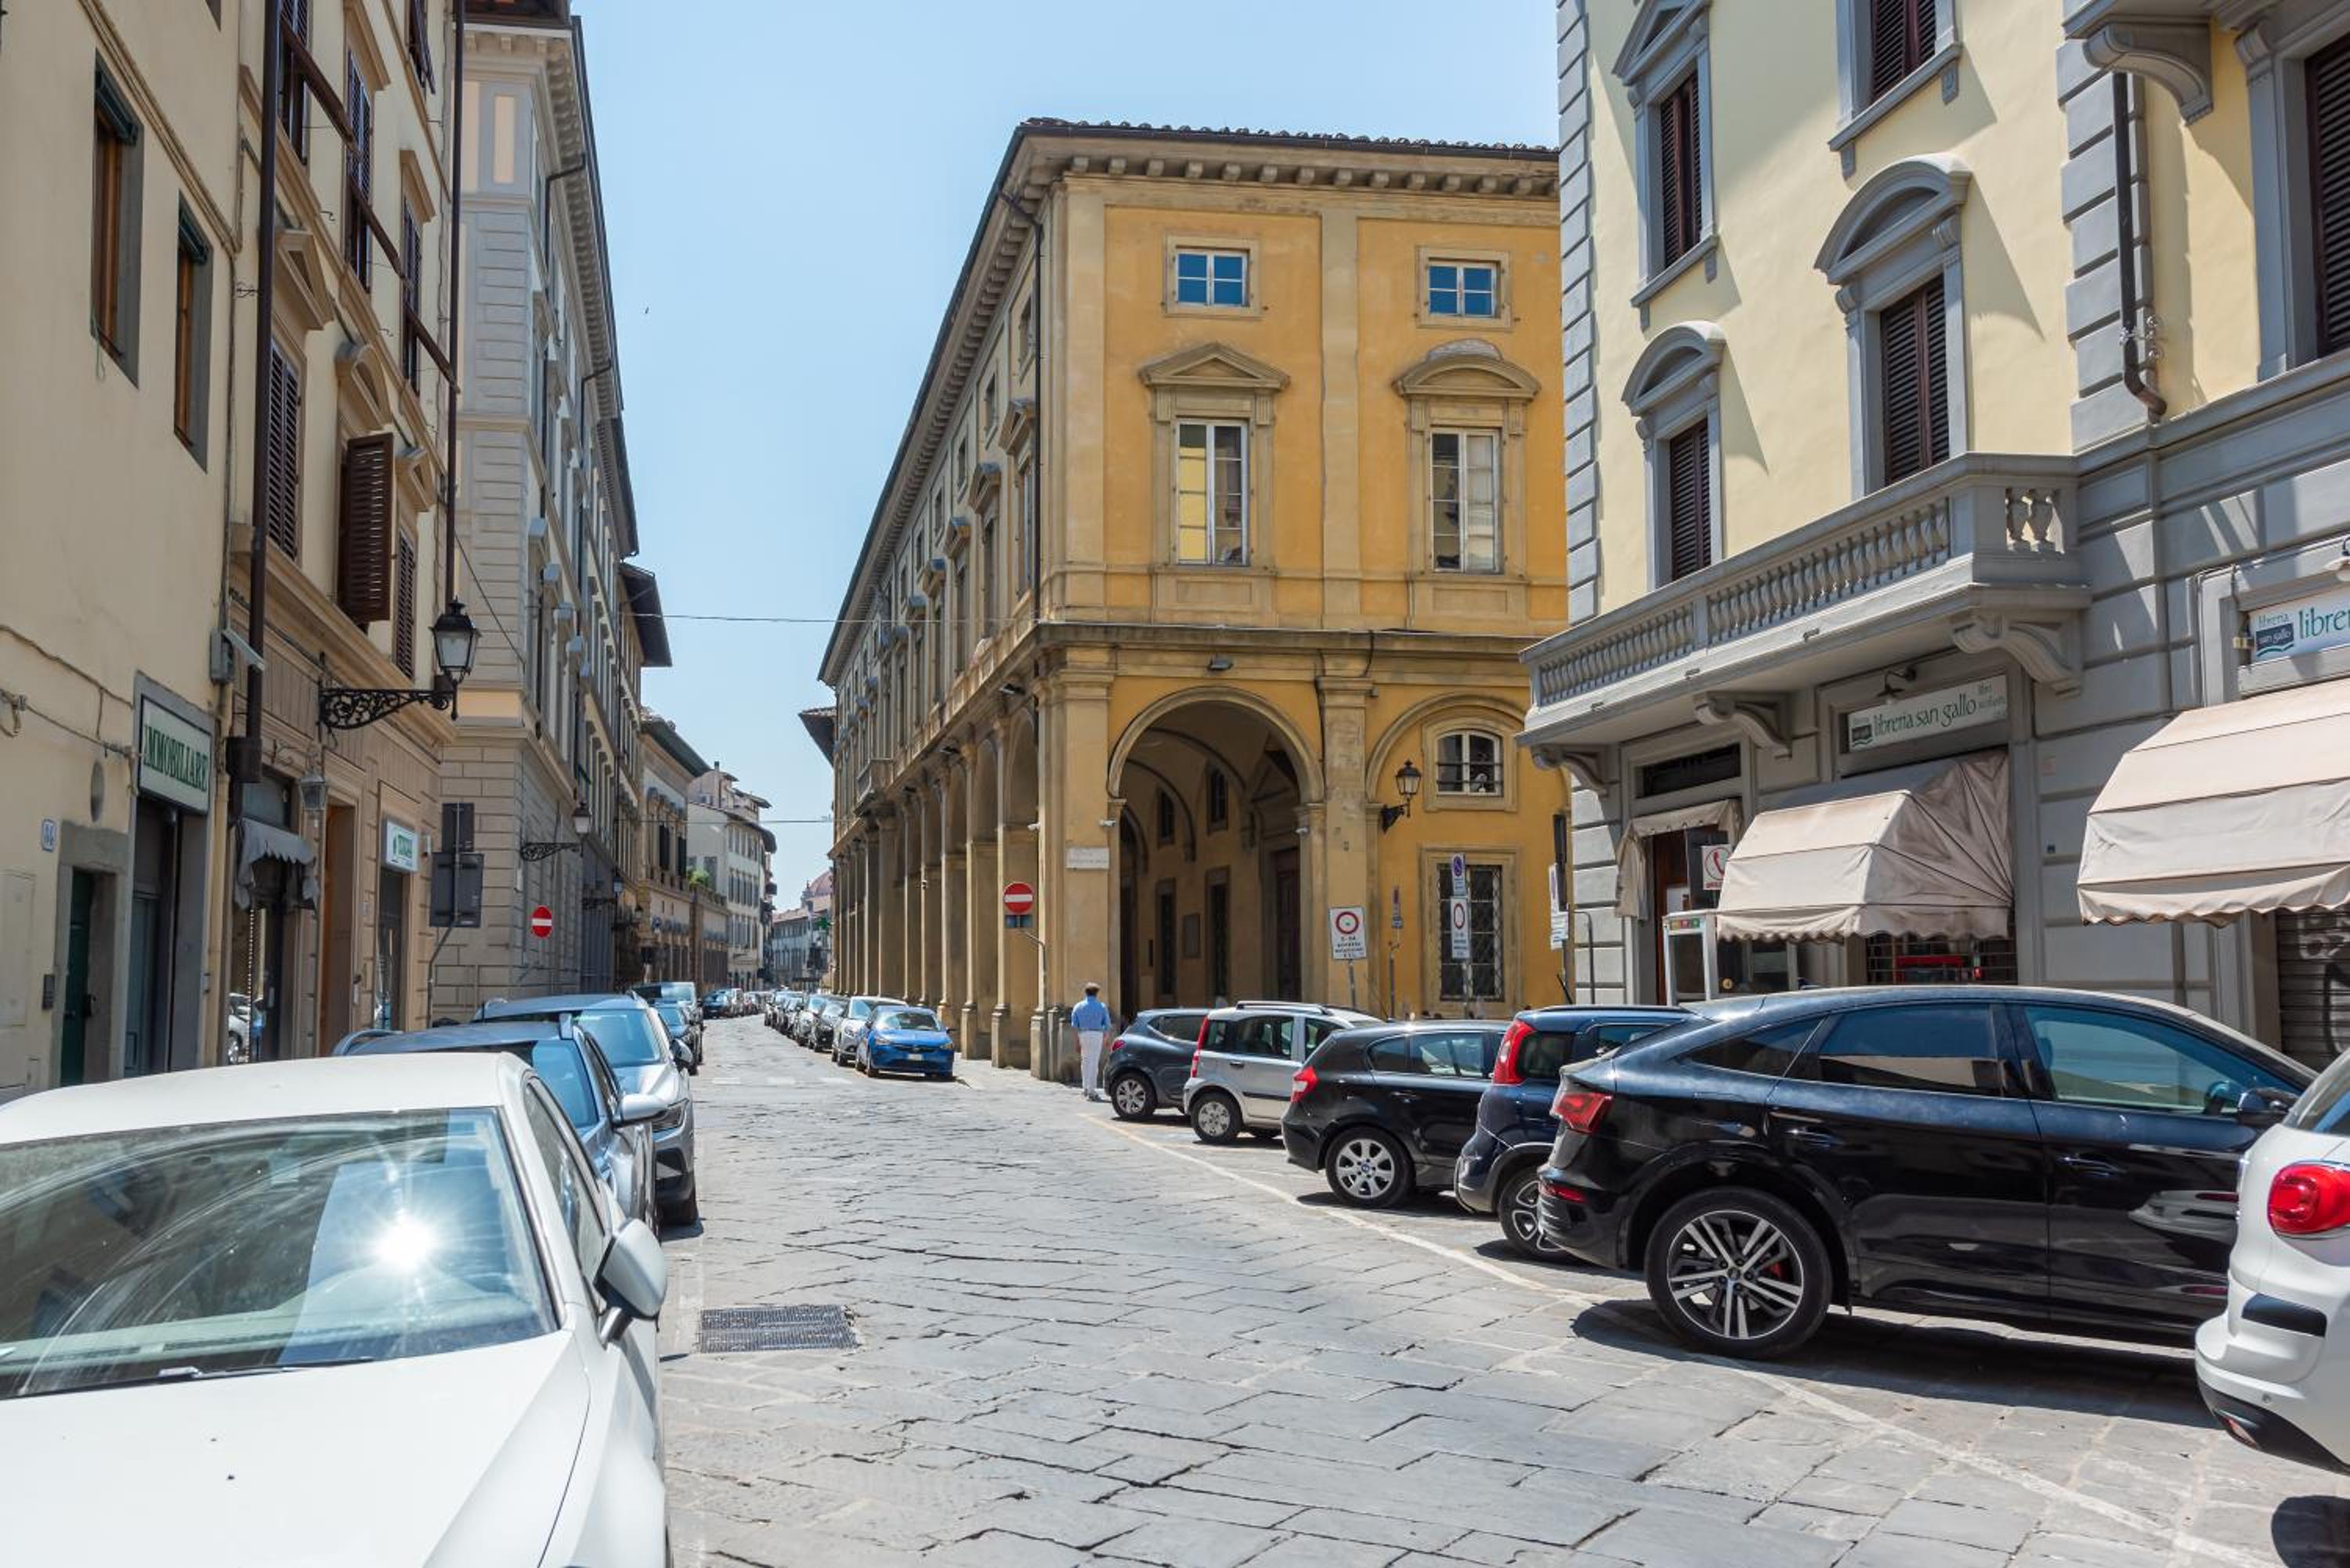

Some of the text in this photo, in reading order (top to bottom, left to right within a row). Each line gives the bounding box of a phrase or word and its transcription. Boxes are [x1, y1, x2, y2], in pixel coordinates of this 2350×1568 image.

[1873, 712, 1914, 738] libreria
[1916, 706, 1940, 728] san
[1941, 692, 1977, 728] gallo
[144, 724, 209, 792] IMMOBILIARE
